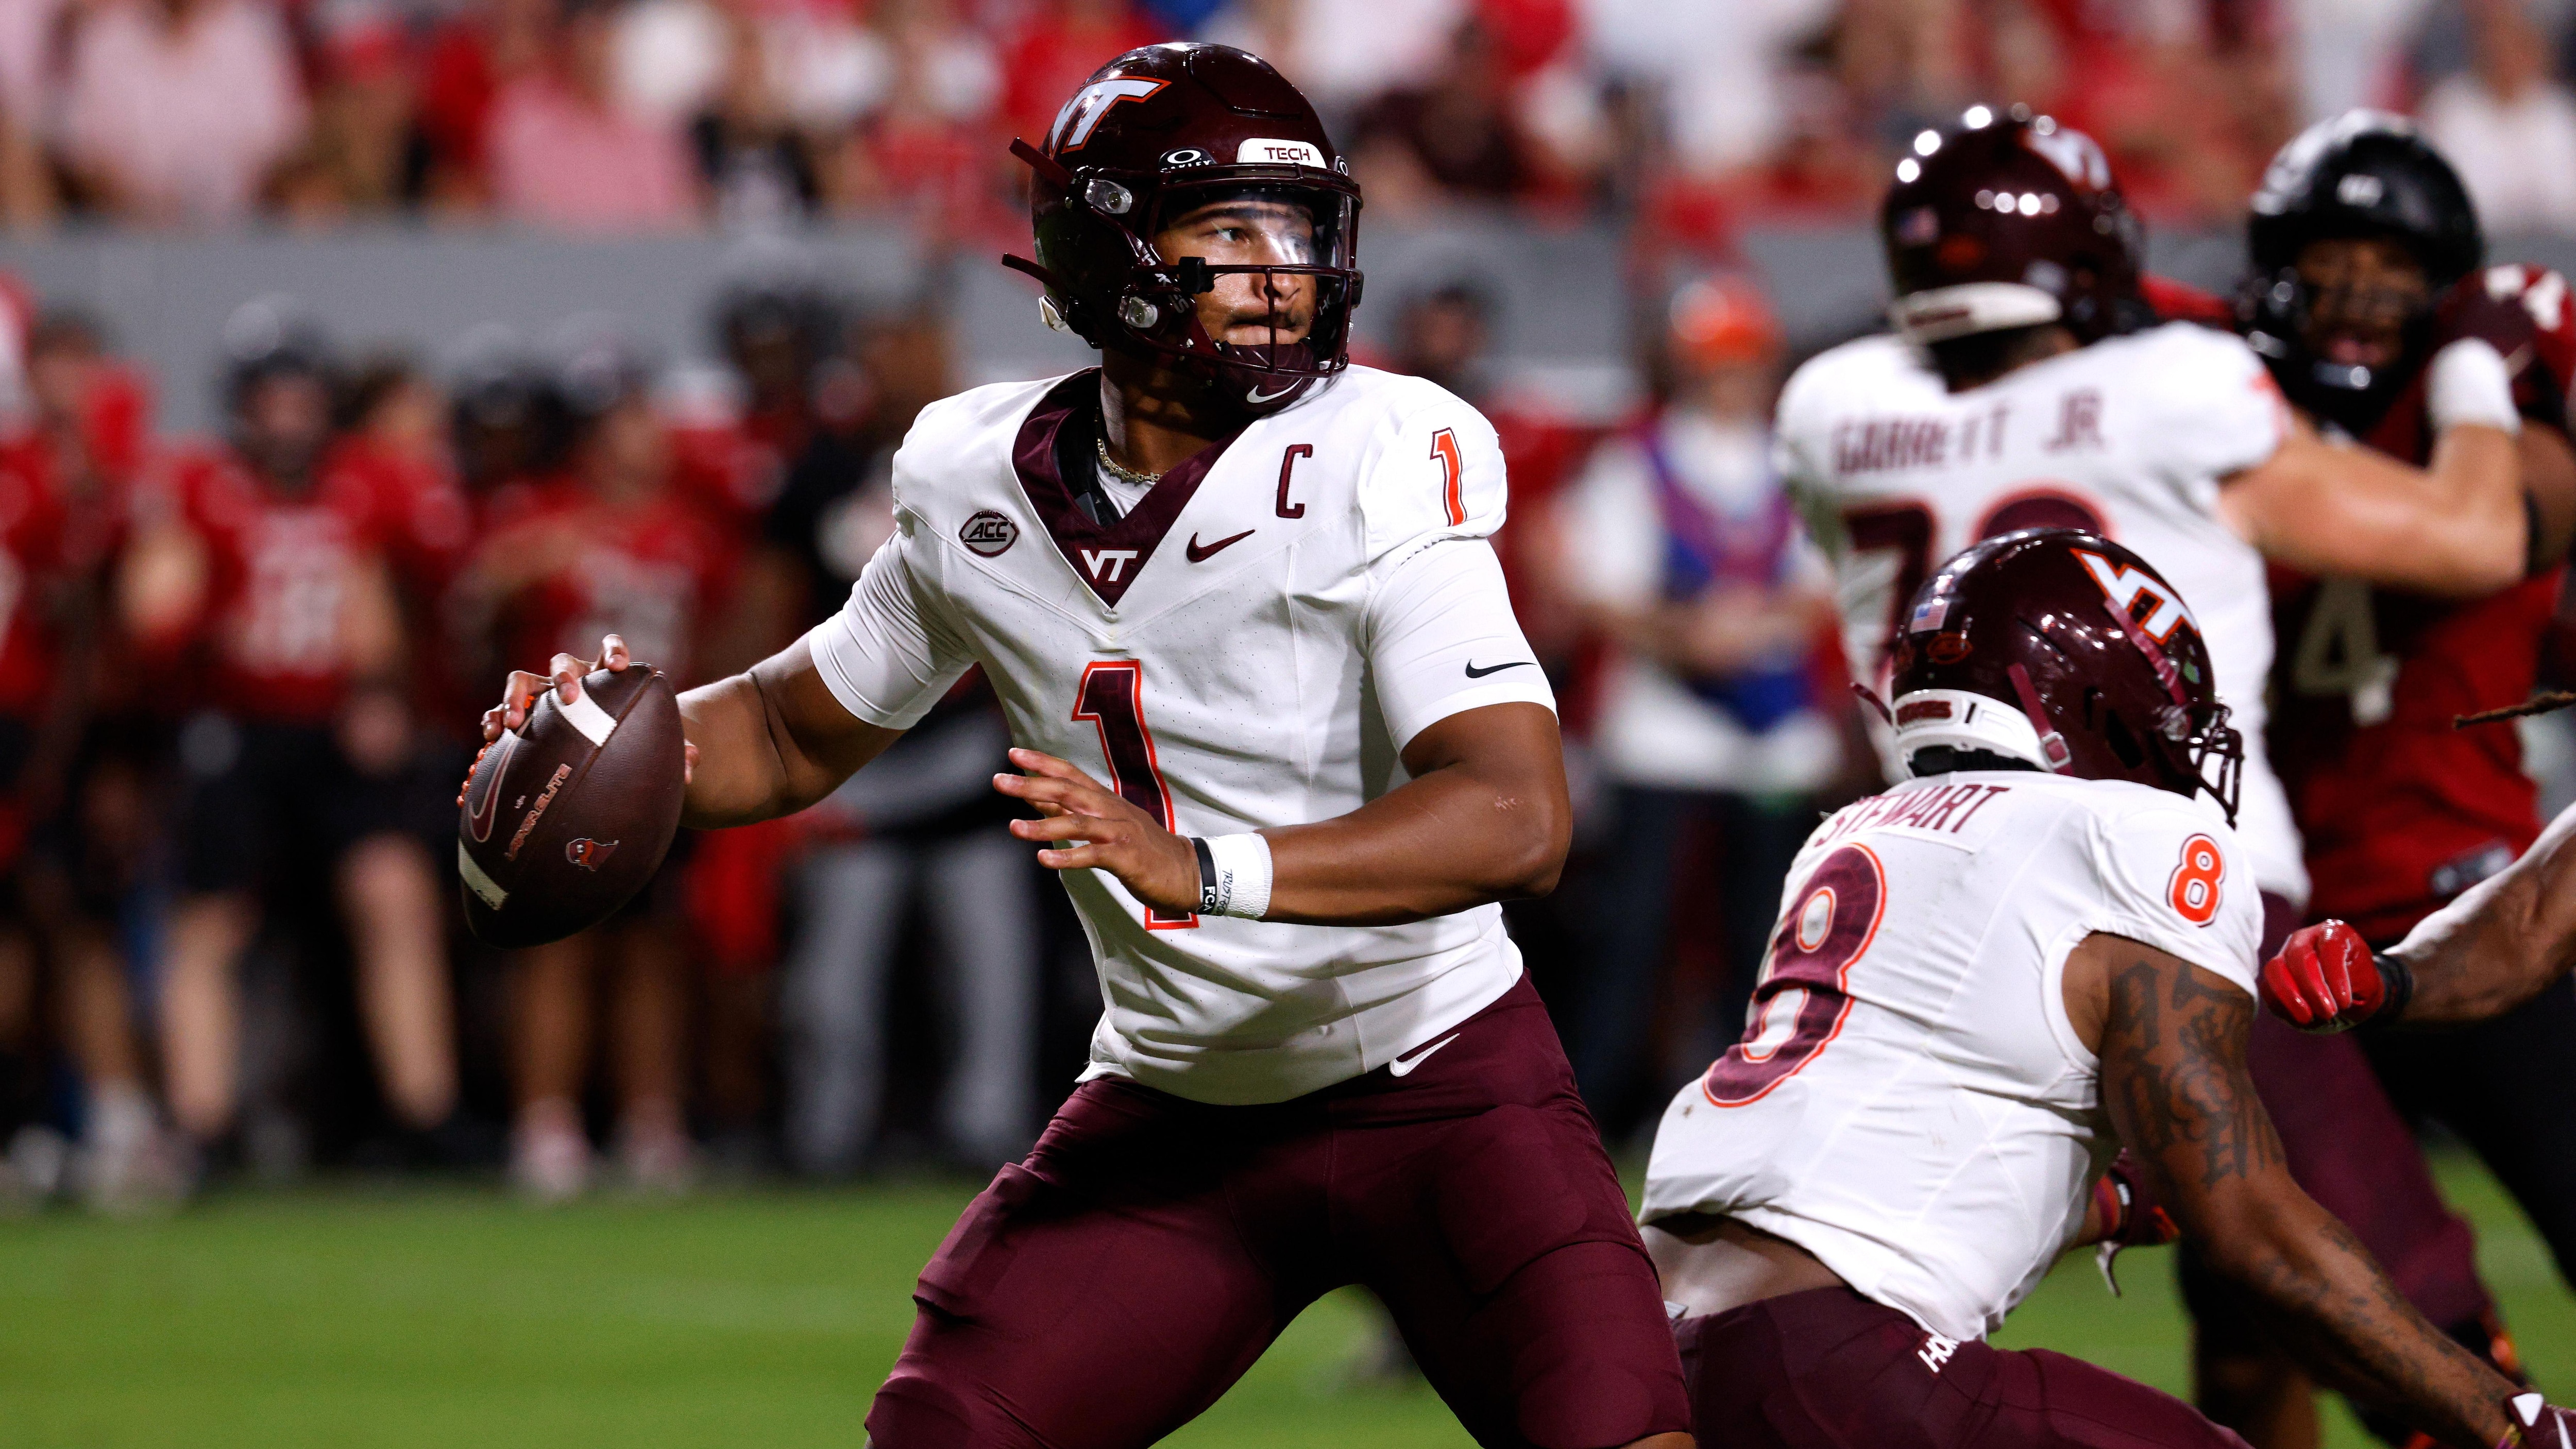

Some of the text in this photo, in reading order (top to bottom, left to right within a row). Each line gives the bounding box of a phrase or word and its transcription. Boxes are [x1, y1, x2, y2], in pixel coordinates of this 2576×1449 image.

[1264, 147, 1311, 161] TECH
[1276, 444, 1313, 519] C
[1430, 427, 1467, 527] 1
[968, 521, 1009, 538] ACC
[1080, 549, 1139, 582] VT
[1071, 658, 1199, 931] 1
[1814, 784, 2011, 848] STEWART
[1204, 886, 1216, 911] FCA
[2166, 833, 2226, 928] 8
[1703, 842, 1887, 1107] 8
[1917, 1335, 1960, 1373] HO
